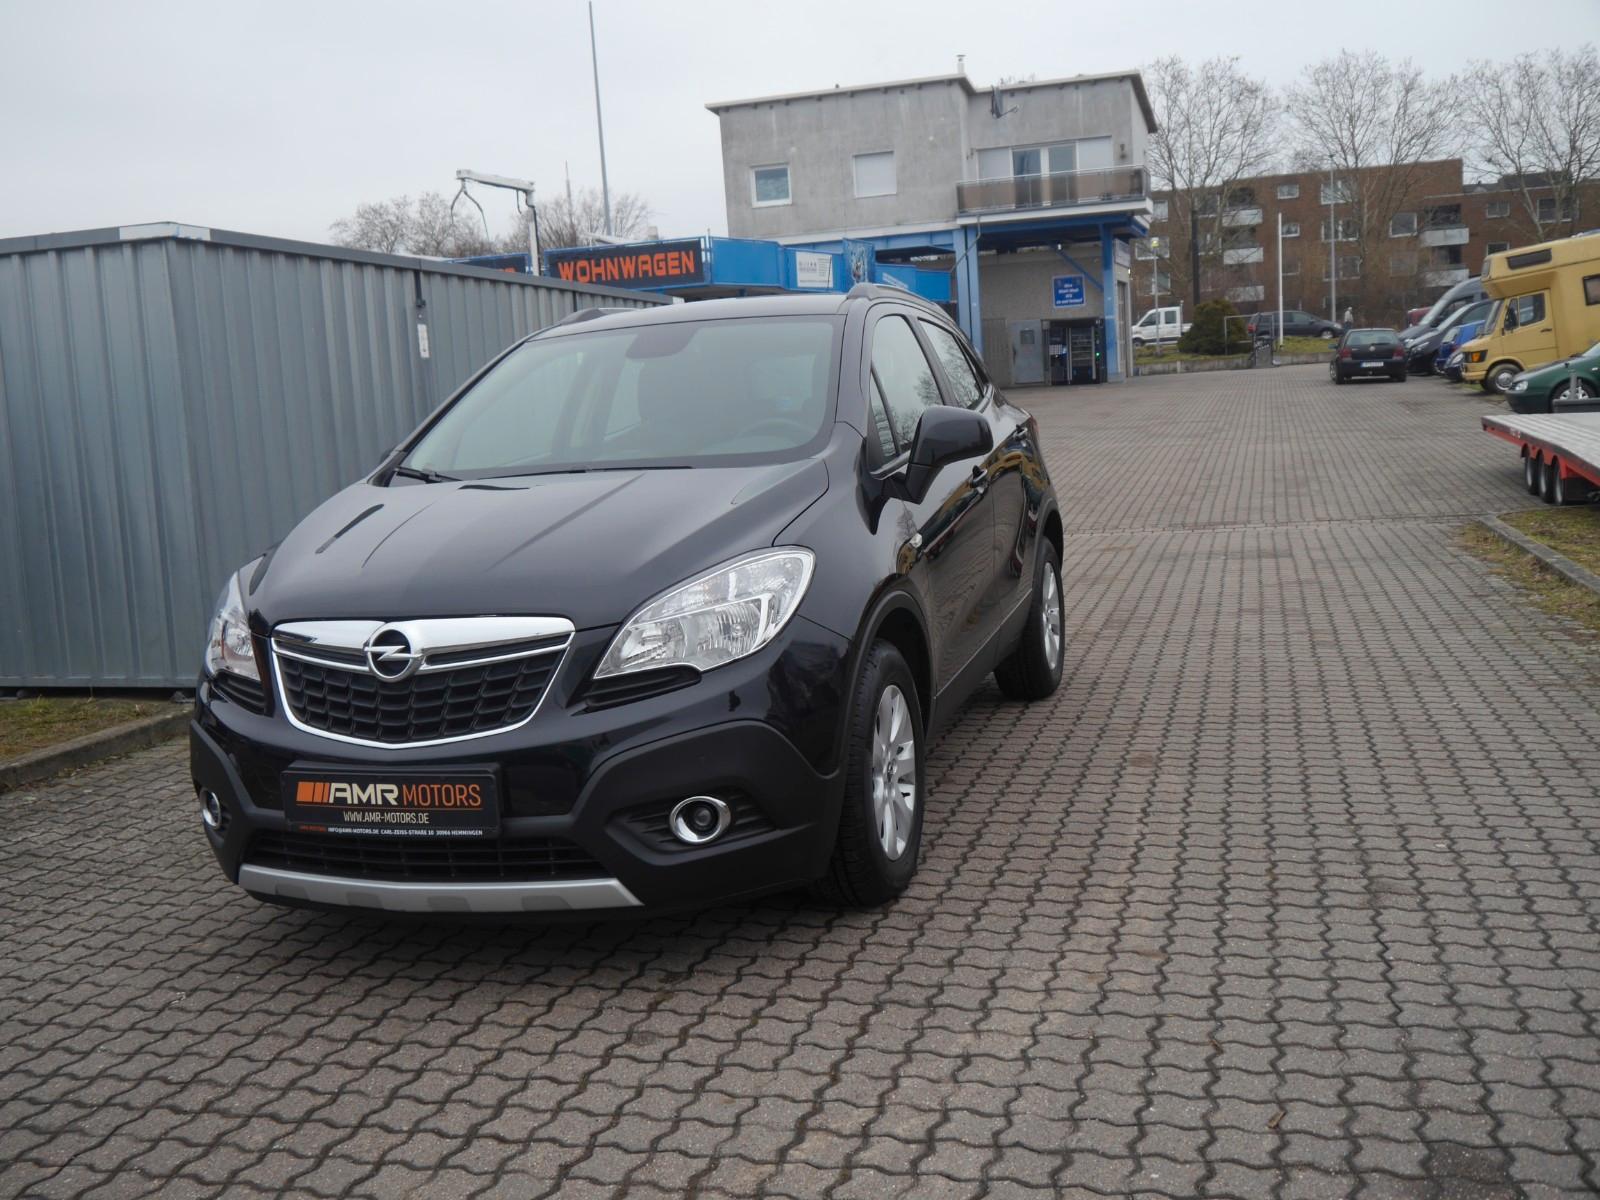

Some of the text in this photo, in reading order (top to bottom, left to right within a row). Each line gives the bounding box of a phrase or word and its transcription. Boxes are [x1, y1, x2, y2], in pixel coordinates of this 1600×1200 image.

[558, 250, 695, 283] WOHNWAGEN
[328, 782, 481, 807] AMR MOTORS
[343, 811, 430, 824] WWW.AMR-MOTORS.DE
